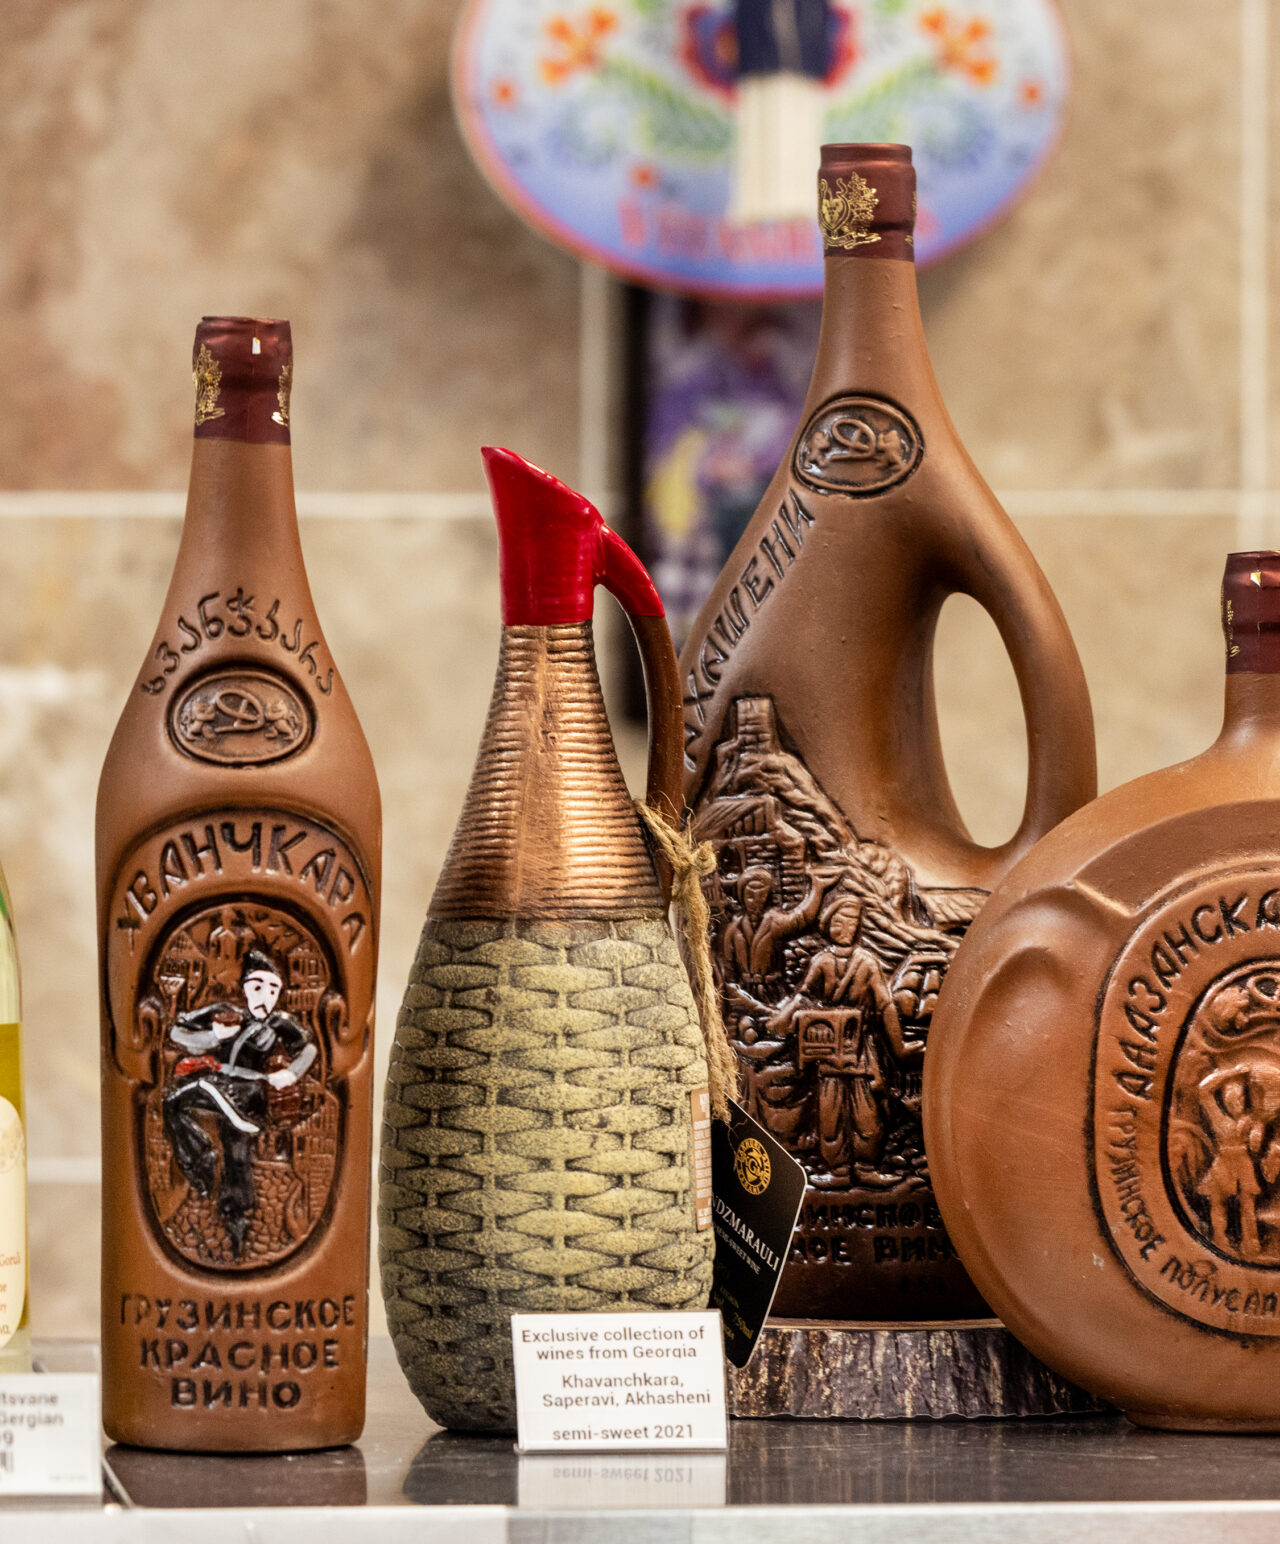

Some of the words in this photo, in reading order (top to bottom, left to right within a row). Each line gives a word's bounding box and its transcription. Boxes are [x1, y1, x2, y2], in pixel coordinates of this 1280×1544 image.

[119, 1293, 355, 1331] ГРУЗИНСКОЕ
[522, 1328, 599, 1342] Exclusive
[603, 1326, 684, 1341] collection
[688, 1326, 705, 1340] of
[139, 1337, 340, 1372] КРАСНОЕ
[536, 1346, 585, 1360] wines
[589, 1345, 628, 1359] from
[633, 1344, 697, 1359] Georgia
[562, 1372, 685, 1389] Khavanchkara,
[170, 1377, 302, 1411] ВИНО
[542, 1393, 620, 1410] Saperavi,
[625, 1389, 711, 1406] Akhasheni
[552, 1425, 649, 1441] semi-sweet
[654, 1424, 694, 1439] 2021
